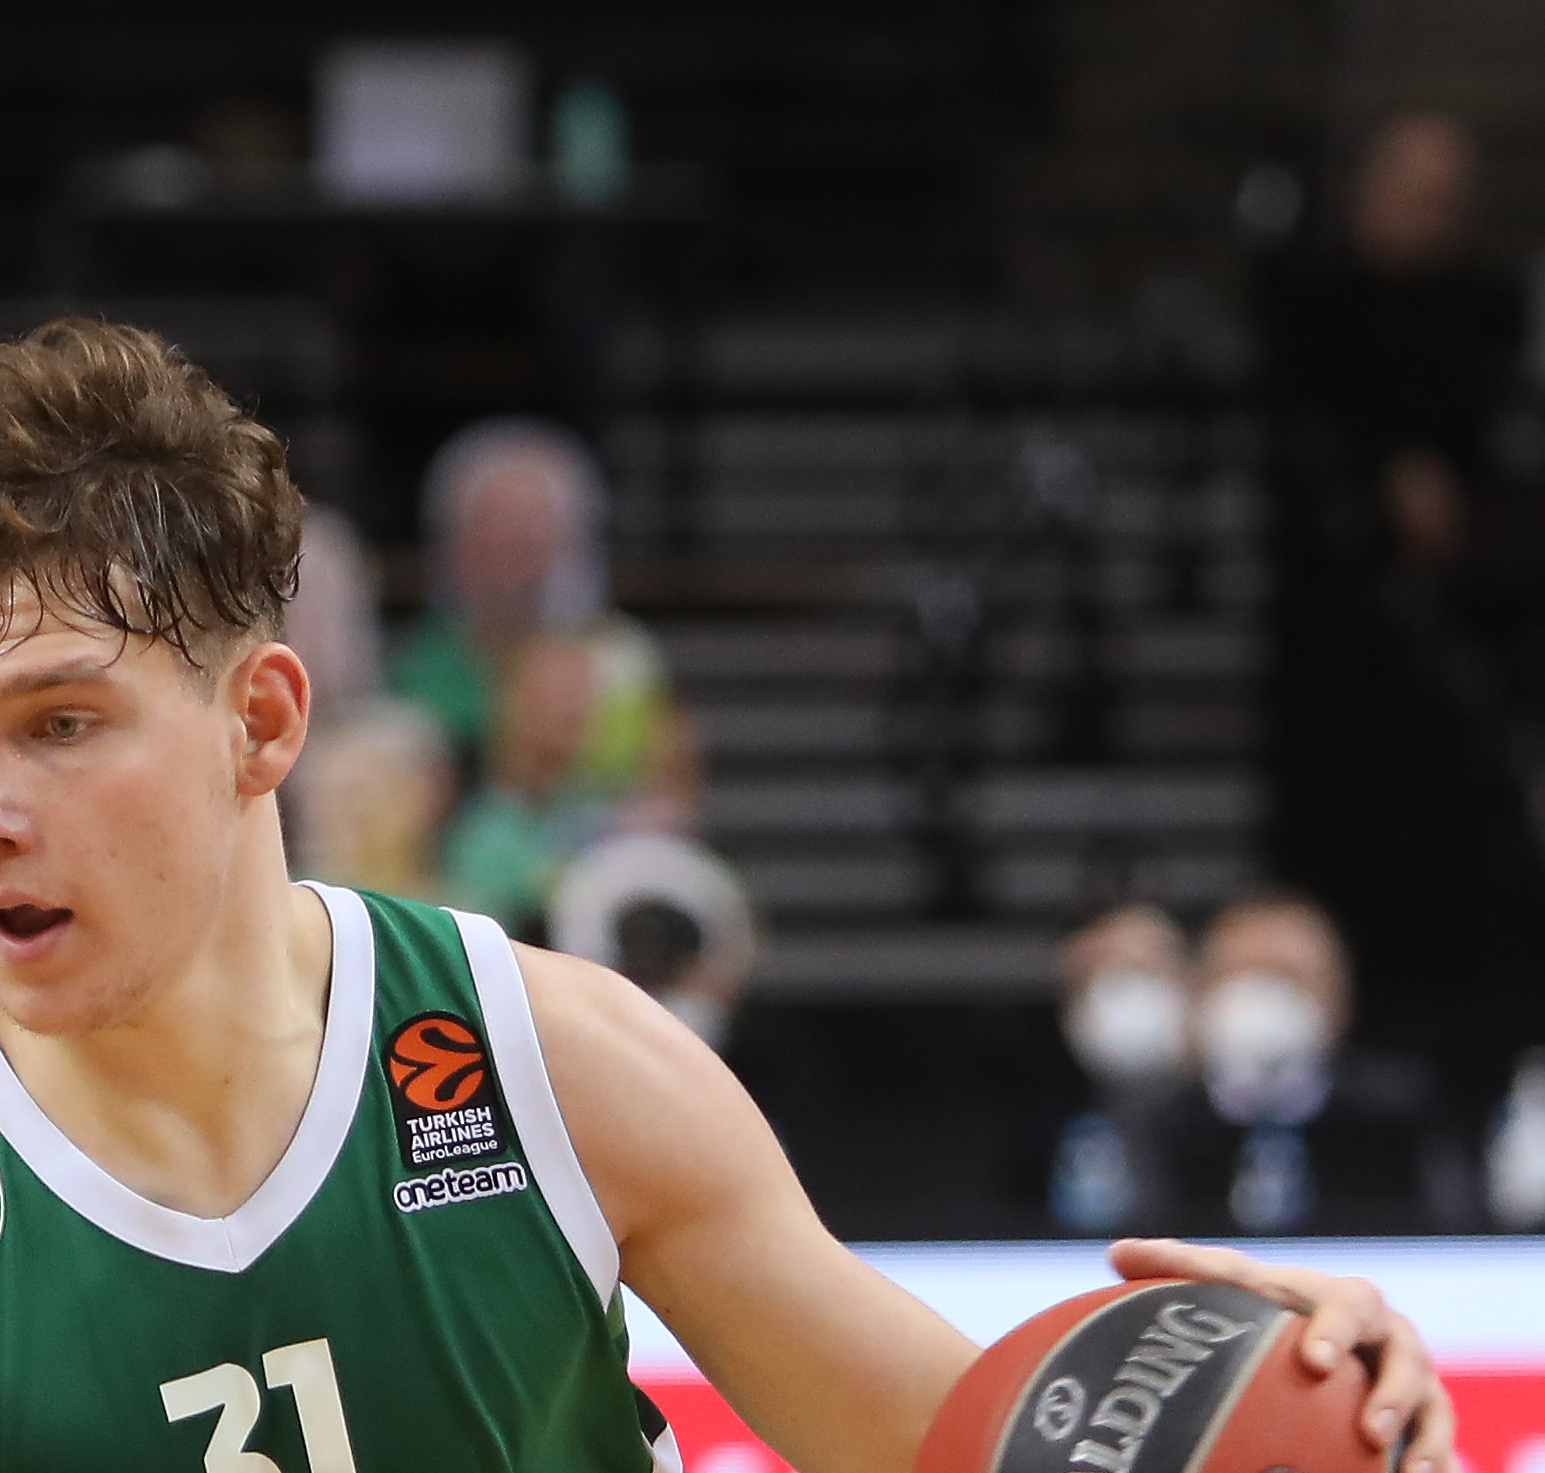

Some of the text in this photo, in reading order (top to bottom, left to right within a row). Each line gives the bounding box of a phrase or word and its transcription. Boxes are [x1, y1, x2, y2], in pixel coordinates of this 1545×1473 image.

[406, 1106, 492, 1134] TURKISH
[411, 1122, 495, 1151] AIRLINES
[412, 1139, 498, 1164] EuroLeague
[394, 1162, 527, 1212] oneteam
